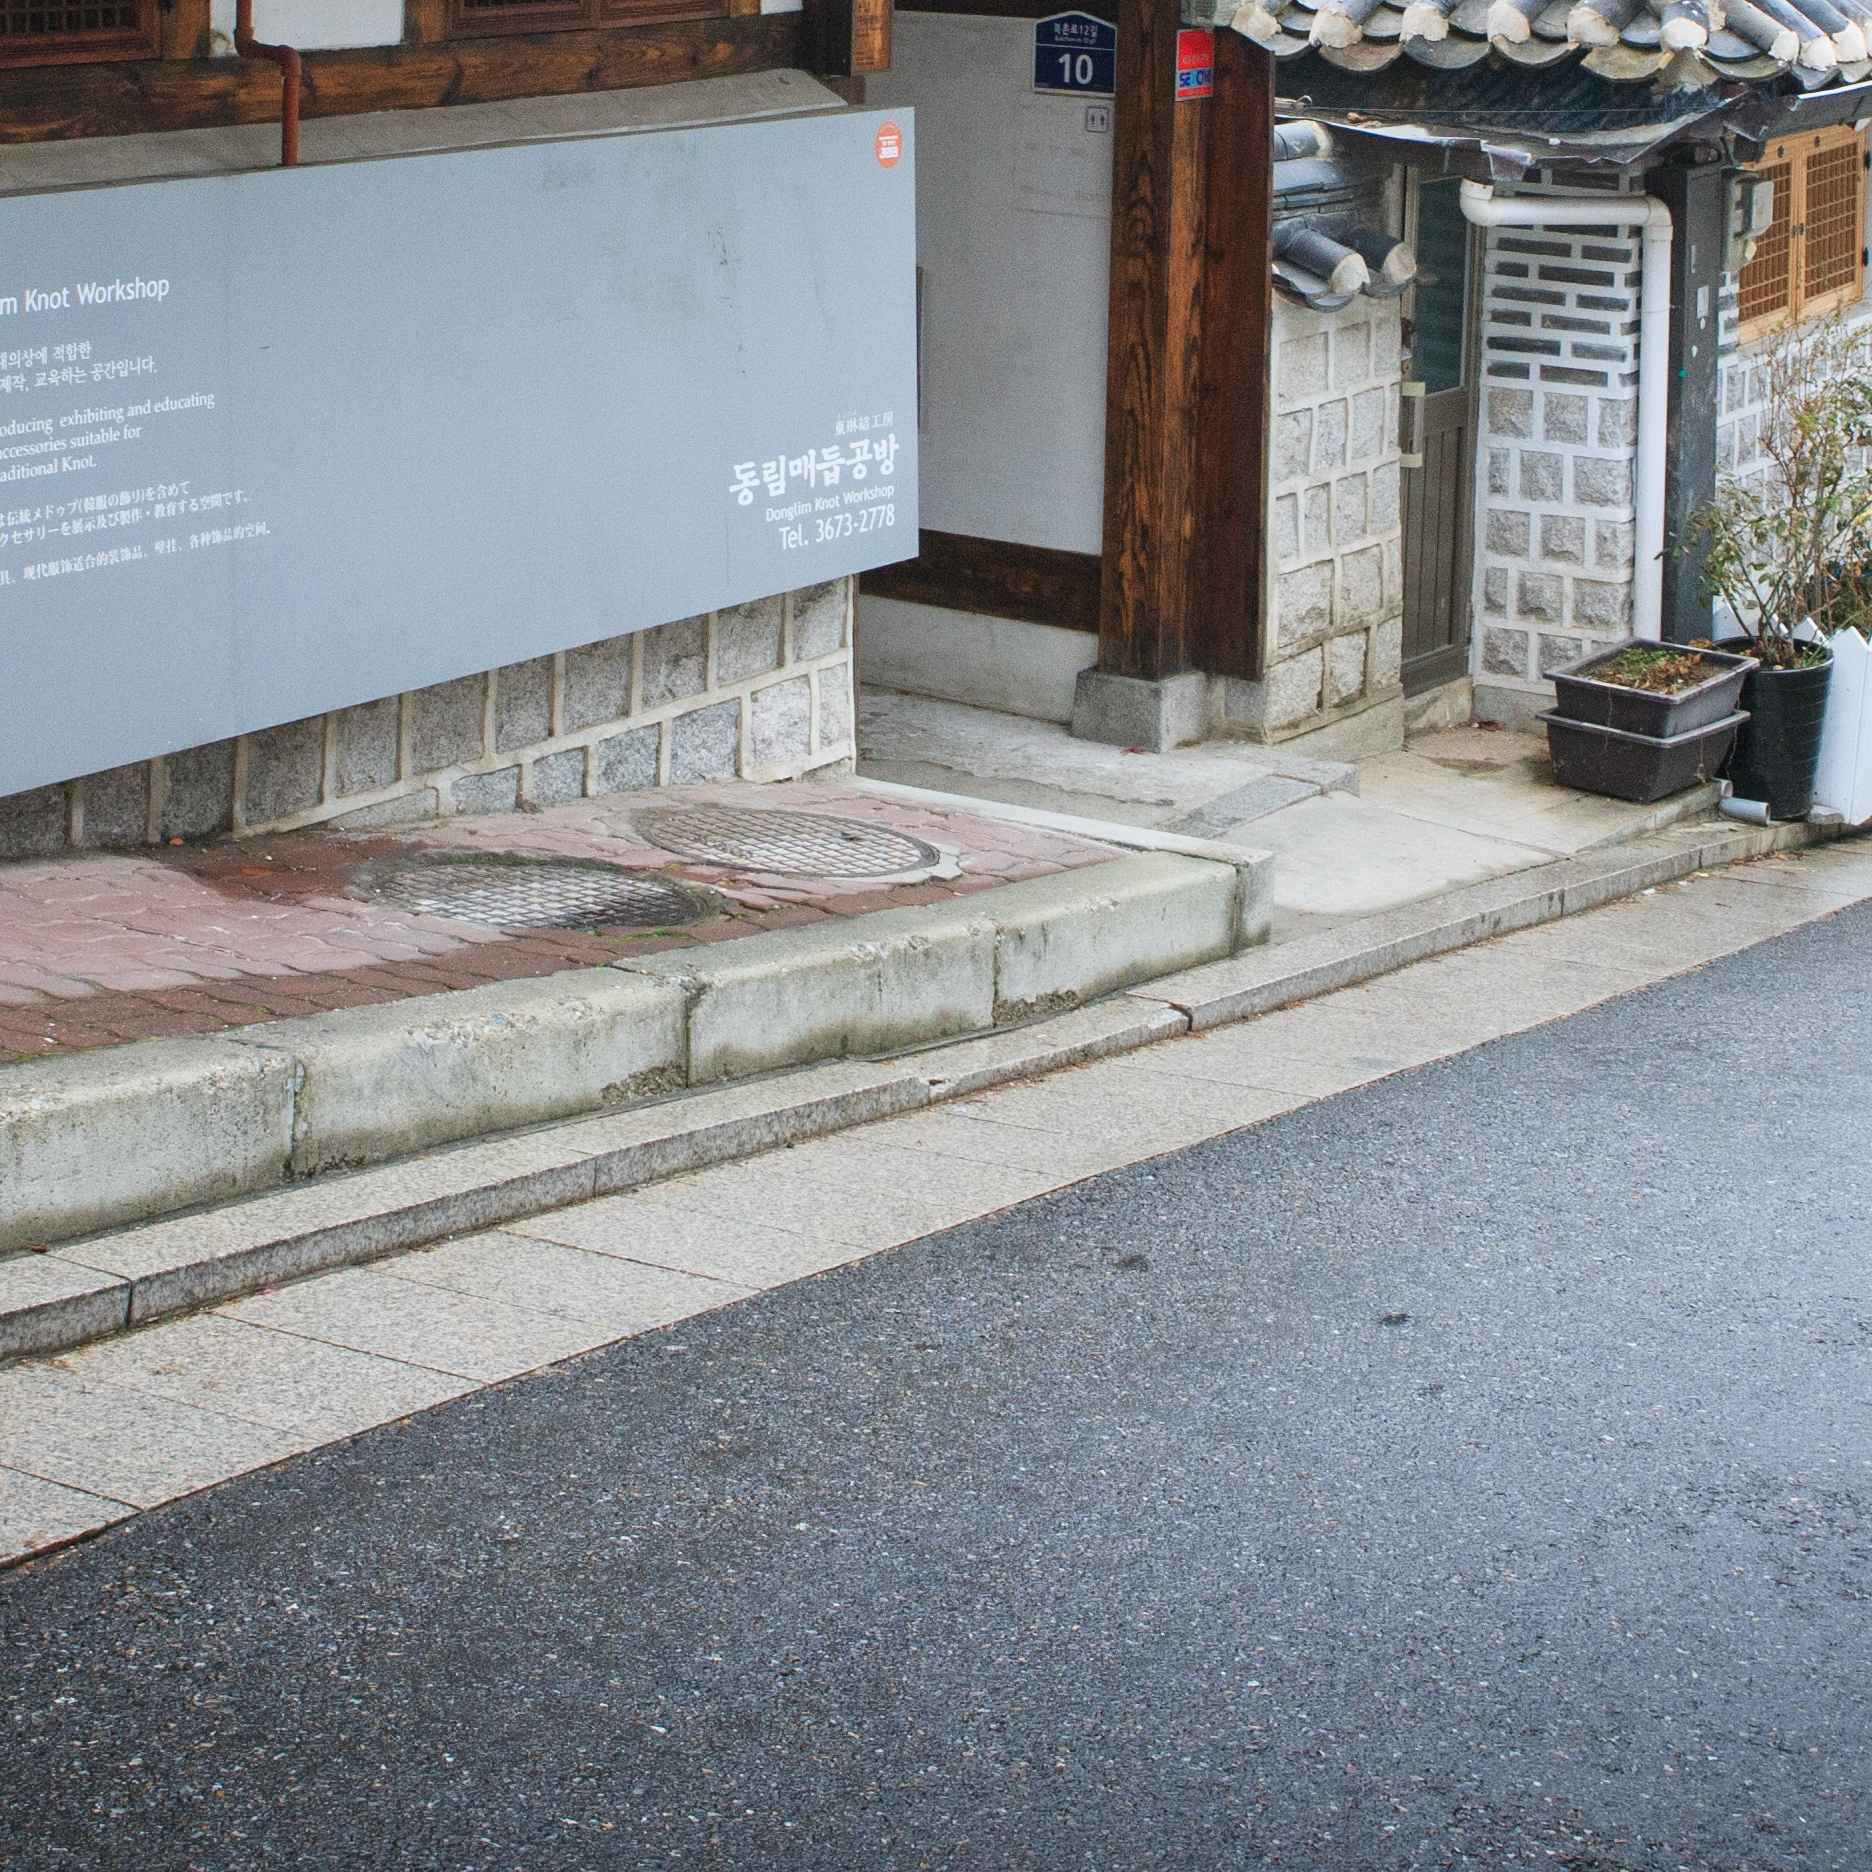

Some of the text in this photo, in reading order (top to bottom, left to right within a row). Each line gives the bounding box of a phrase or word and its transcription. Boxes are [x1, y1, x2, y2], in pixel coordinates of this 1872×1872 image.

[1058, 53, 1094, 85] 10
[24, 286, 71, 312] Knot
[77, 274, 170, 306] Workshop
[53, 340, 92, 363] 적합한
[34, 366, 87, 388] 교육하는
[90, 355, 158, 382] 공간입니다.
[59, 405, 124, 427] exhibiting
[128, 399, 151, 418] and
[154, 391, 215, 414] educating
[70, 427, 120, 449] suitable
[123, 424, 144, 440] for
[62, 454, 97, 472] Knot.
[729, 433, 899, 506] 동림매듭공방
[766, 485, 895, 522] Donglim Knot Workshop
[779, 503, 895, 549] Tel. 3673-2778
